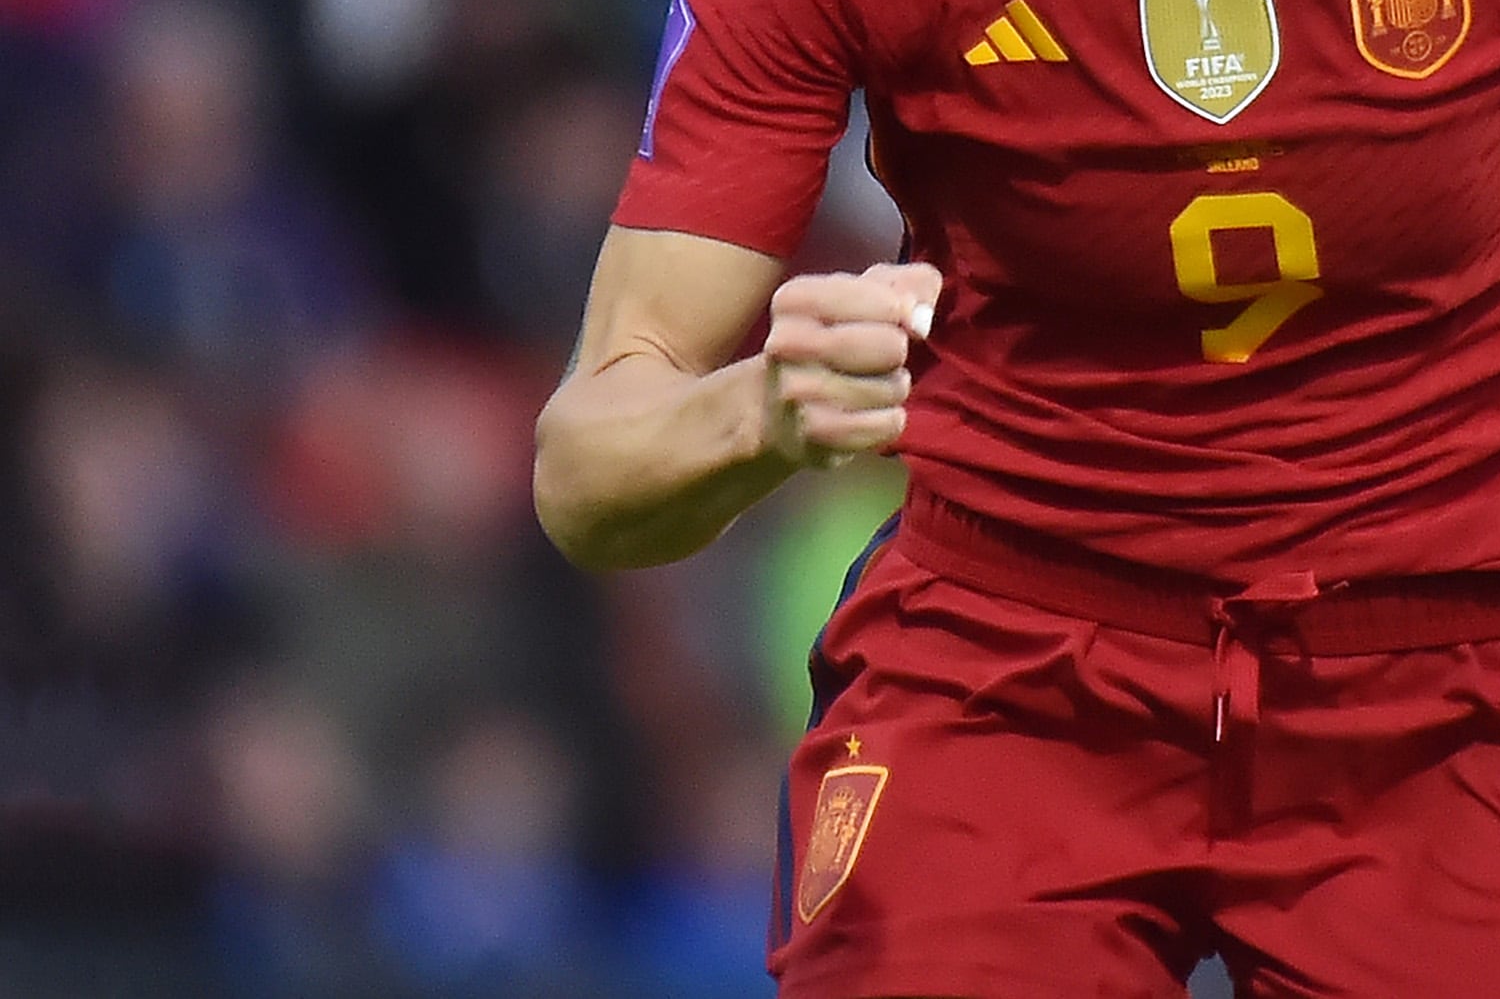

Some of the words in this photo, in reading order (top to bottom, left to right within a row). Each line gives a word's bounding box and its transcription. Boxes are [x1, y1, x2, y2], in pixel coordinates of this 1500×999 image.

[1185, 54, 1244, 78] FIFA
[1200, 84, 1233, 100] 2023
[1170, 192, 1325, 363] 9
